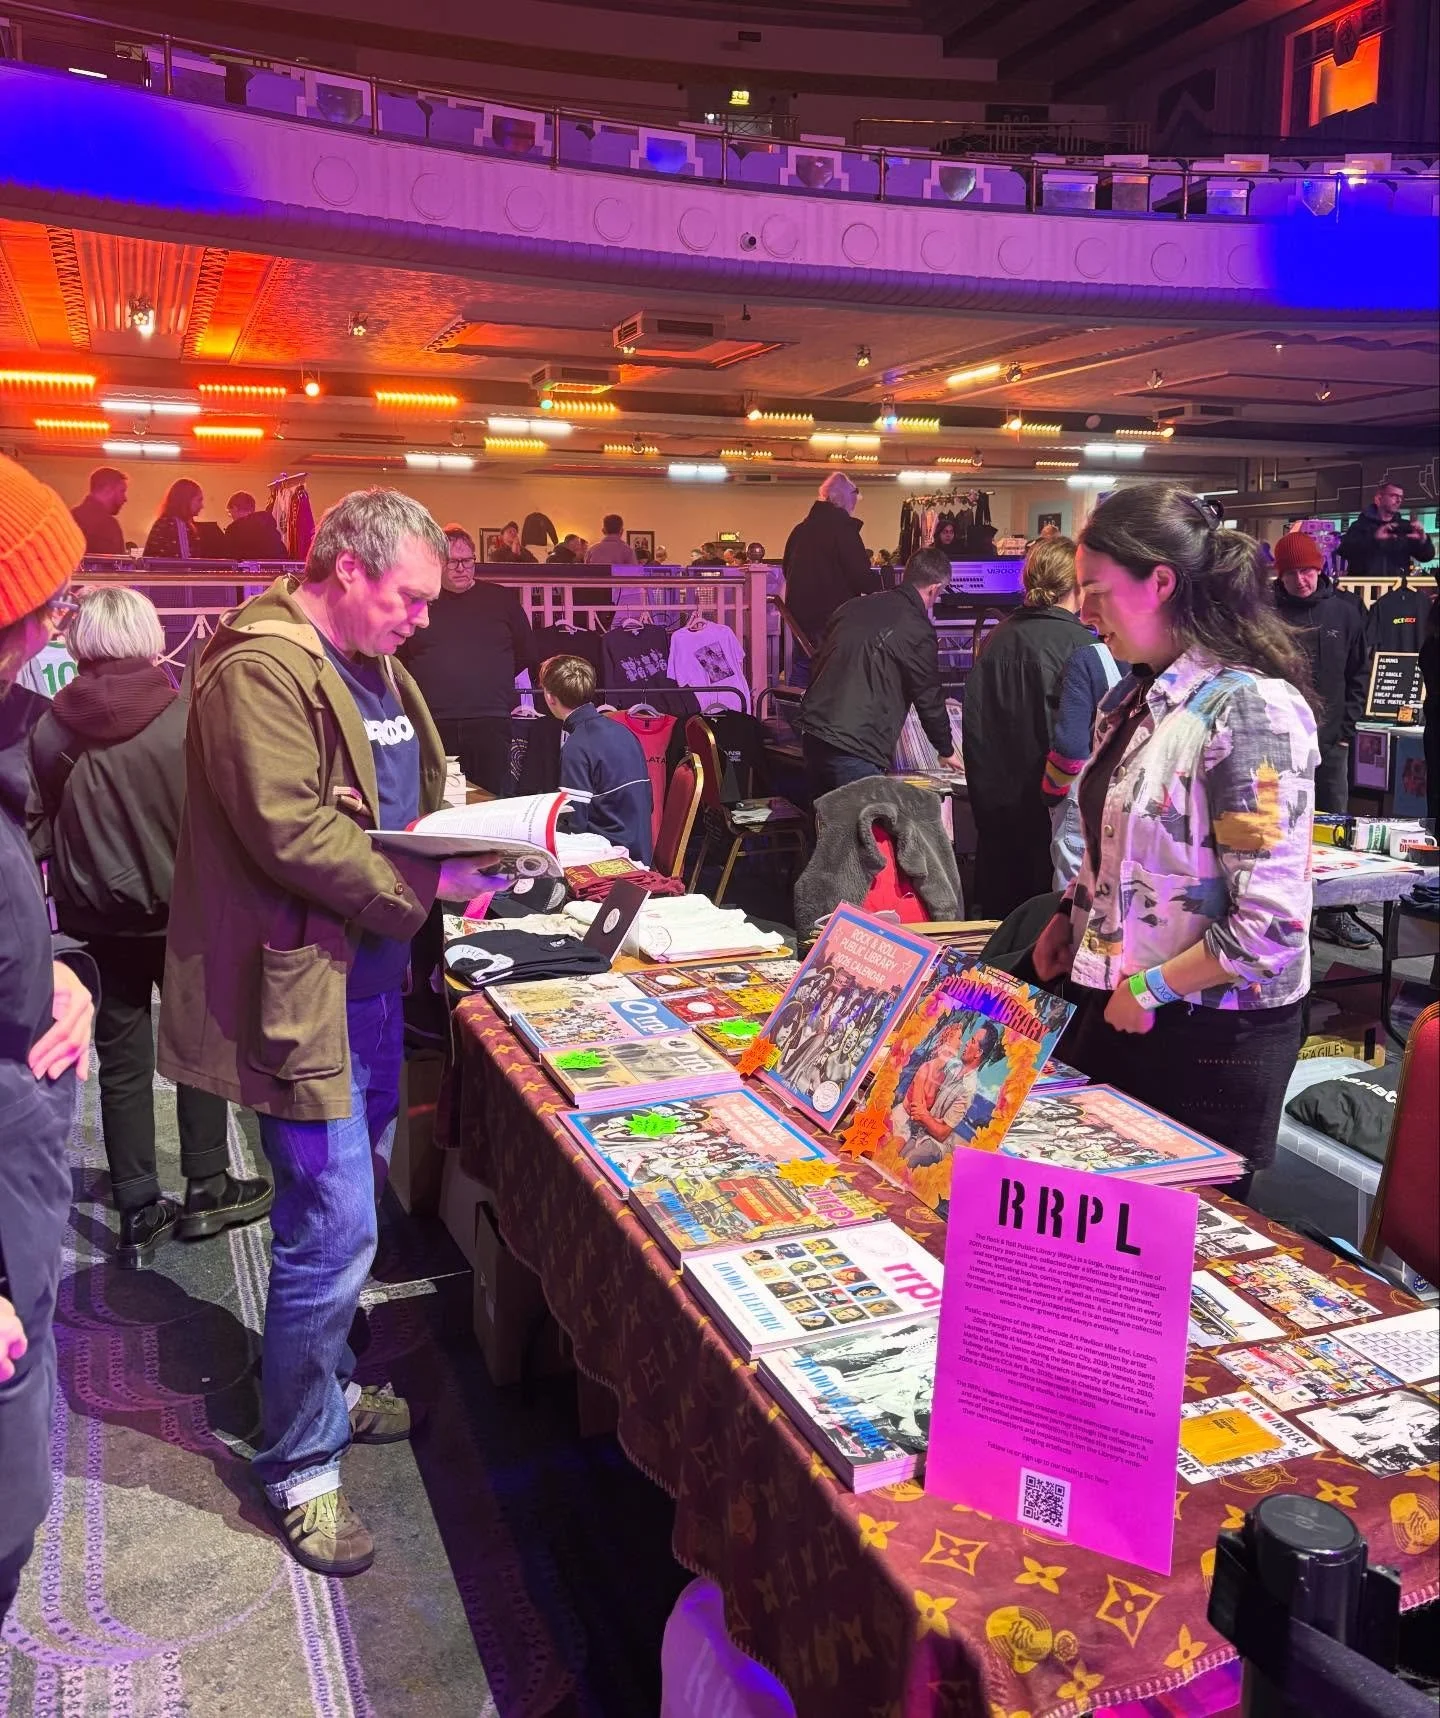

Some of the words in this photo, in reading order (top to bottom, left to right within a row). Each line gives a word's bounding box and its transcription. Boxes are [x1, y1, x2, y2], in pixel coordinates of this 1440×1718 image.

[840, 937, 864, 957] PUBLIC
[864, 949, 897, 970] LIBRARY
[851, 929, 869, 946] ROCK
[871, 939, 878, 948] &
[877, 941, 897, 958] ROLL
[833, 952, 850, 967] 2026
[850, 961, 886, 984] CALENDAR
[940, 975, 992, 1008] PUBLIC
[989, 990, 1050, 1043] LIBRARY
[998, 1178, 1141, 1256] RRPL
[712, 1262, 748, 1298] LONDON
[1130, 1268, 1153, 1279] archive
[1143, 1308, 1161, 1319] every
